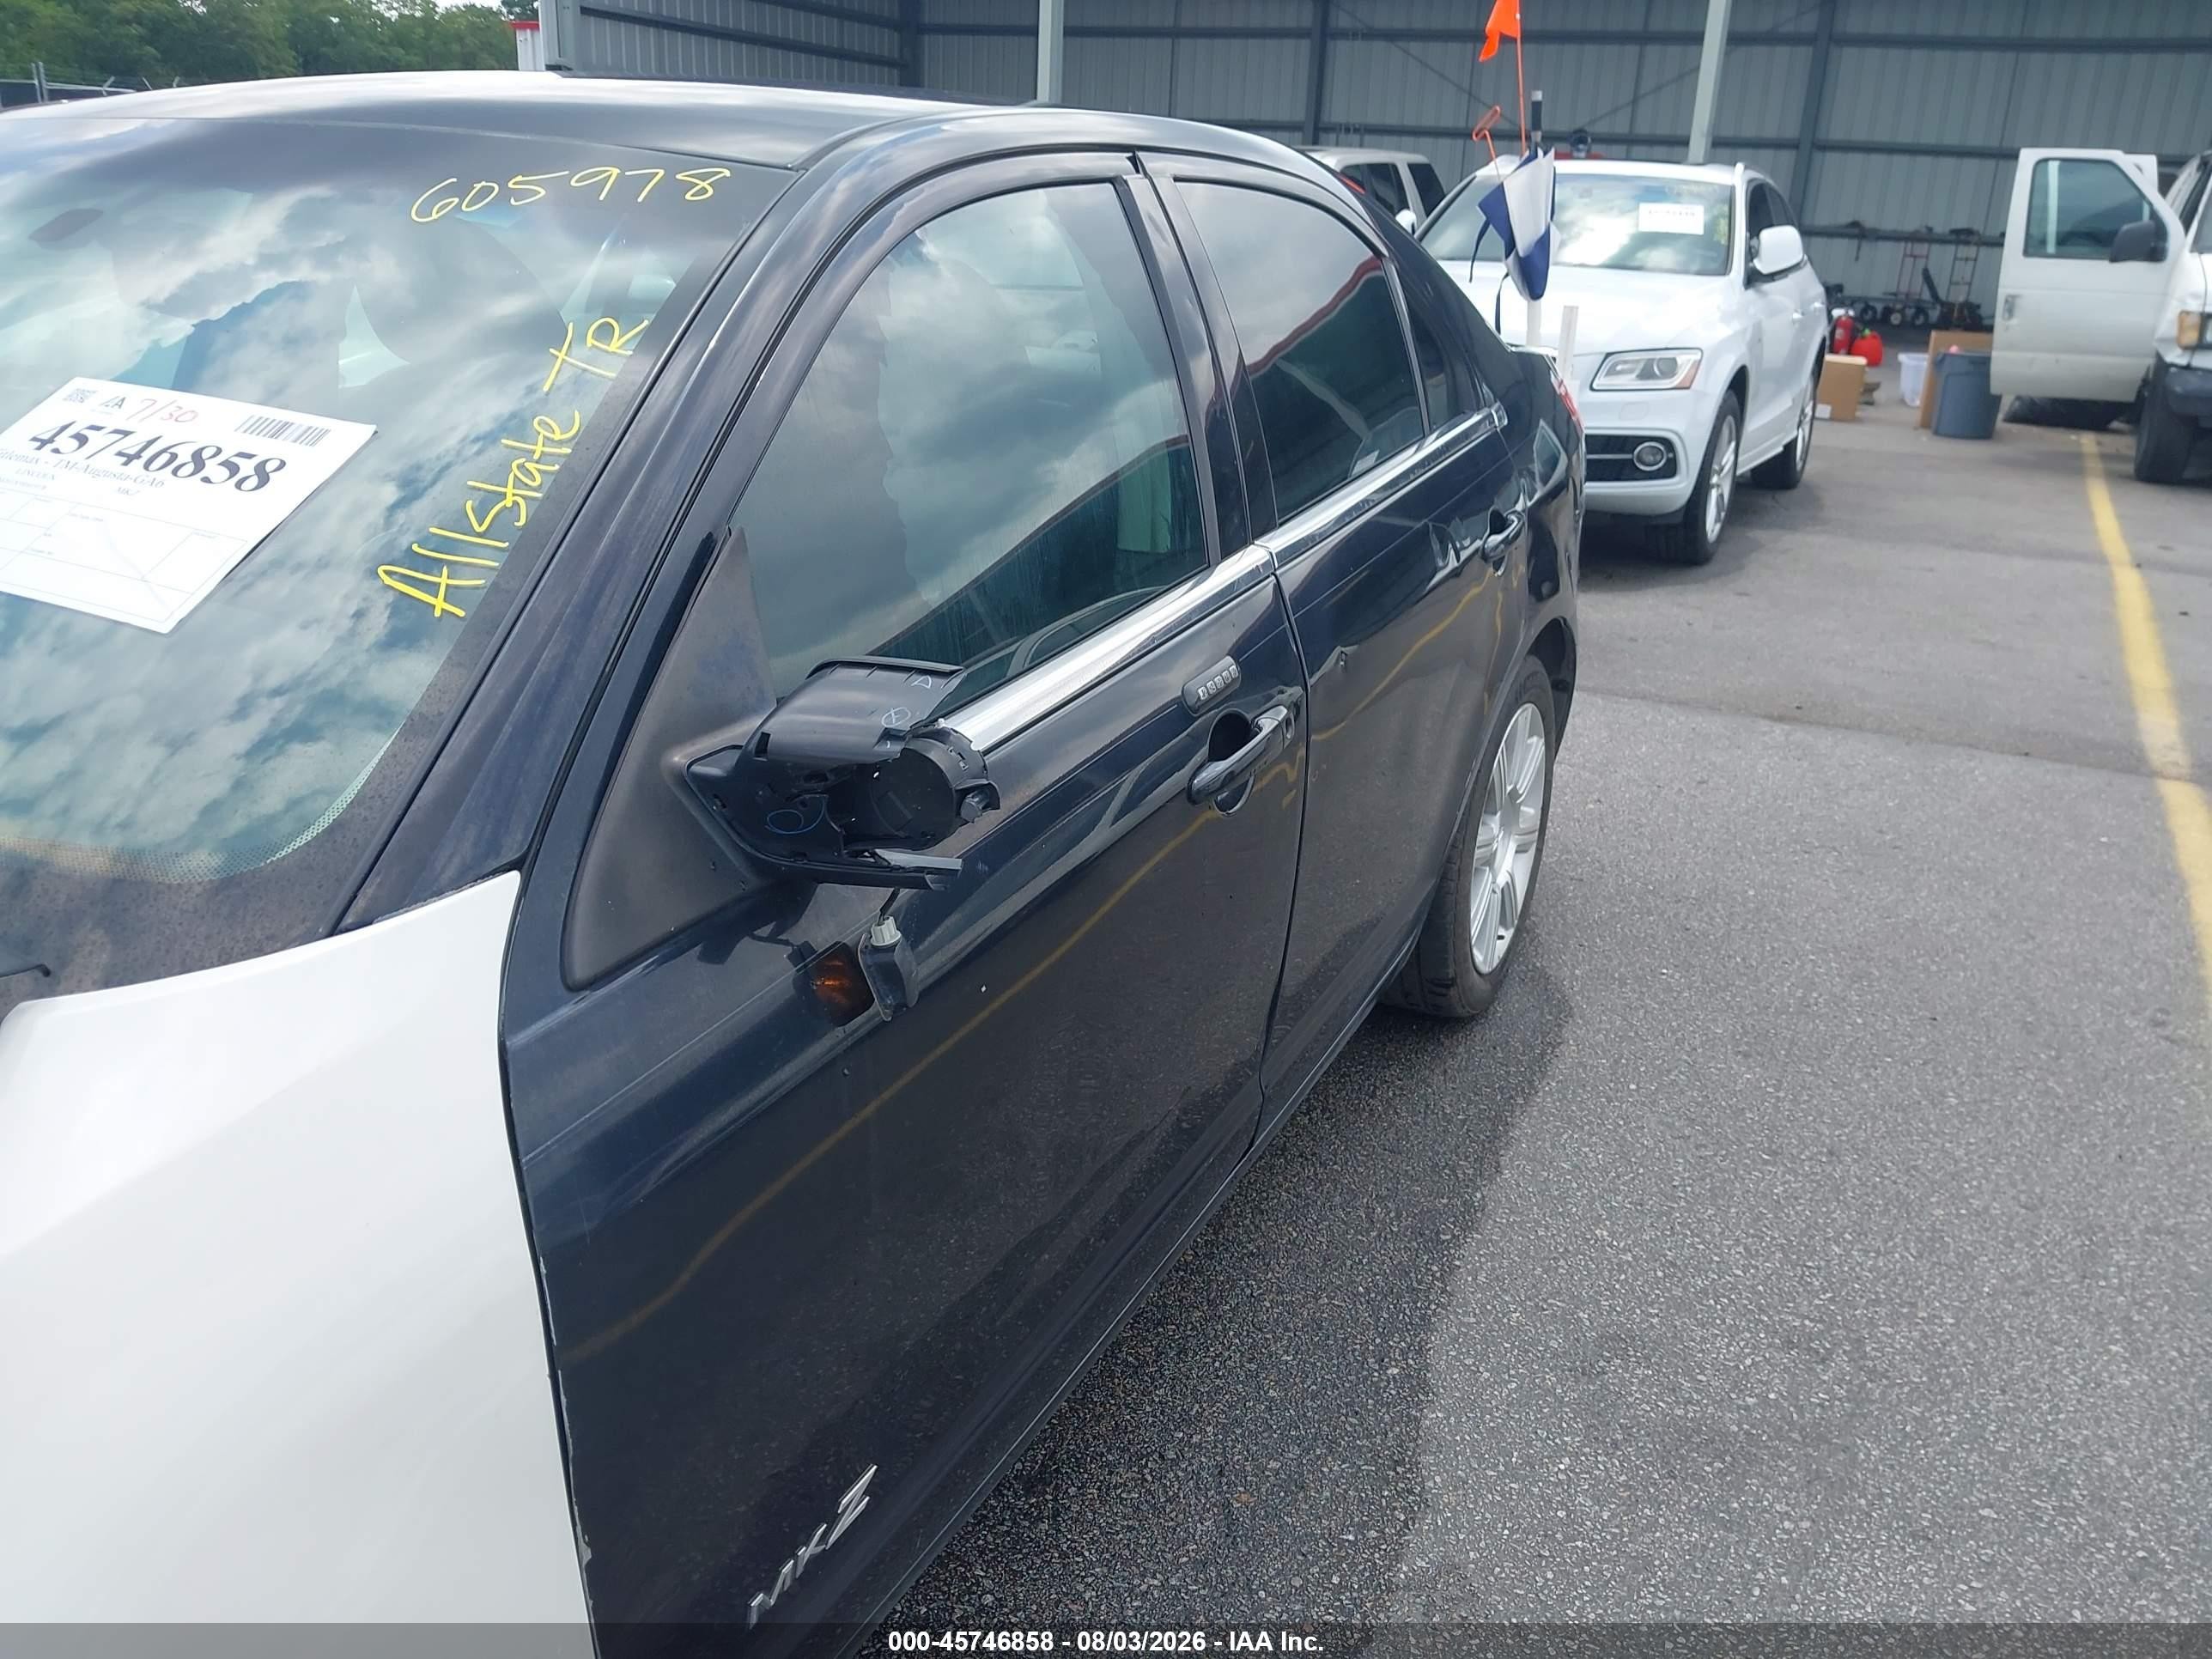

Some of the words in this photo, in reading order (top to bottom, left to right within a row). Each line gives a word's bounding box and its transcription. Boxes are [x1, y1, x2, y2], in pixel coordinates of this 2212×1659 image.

[410, 167, 731, 222] 605978
[28, 420, 287, 493] 45746858
[376, 409, 581, 618] Allstate
